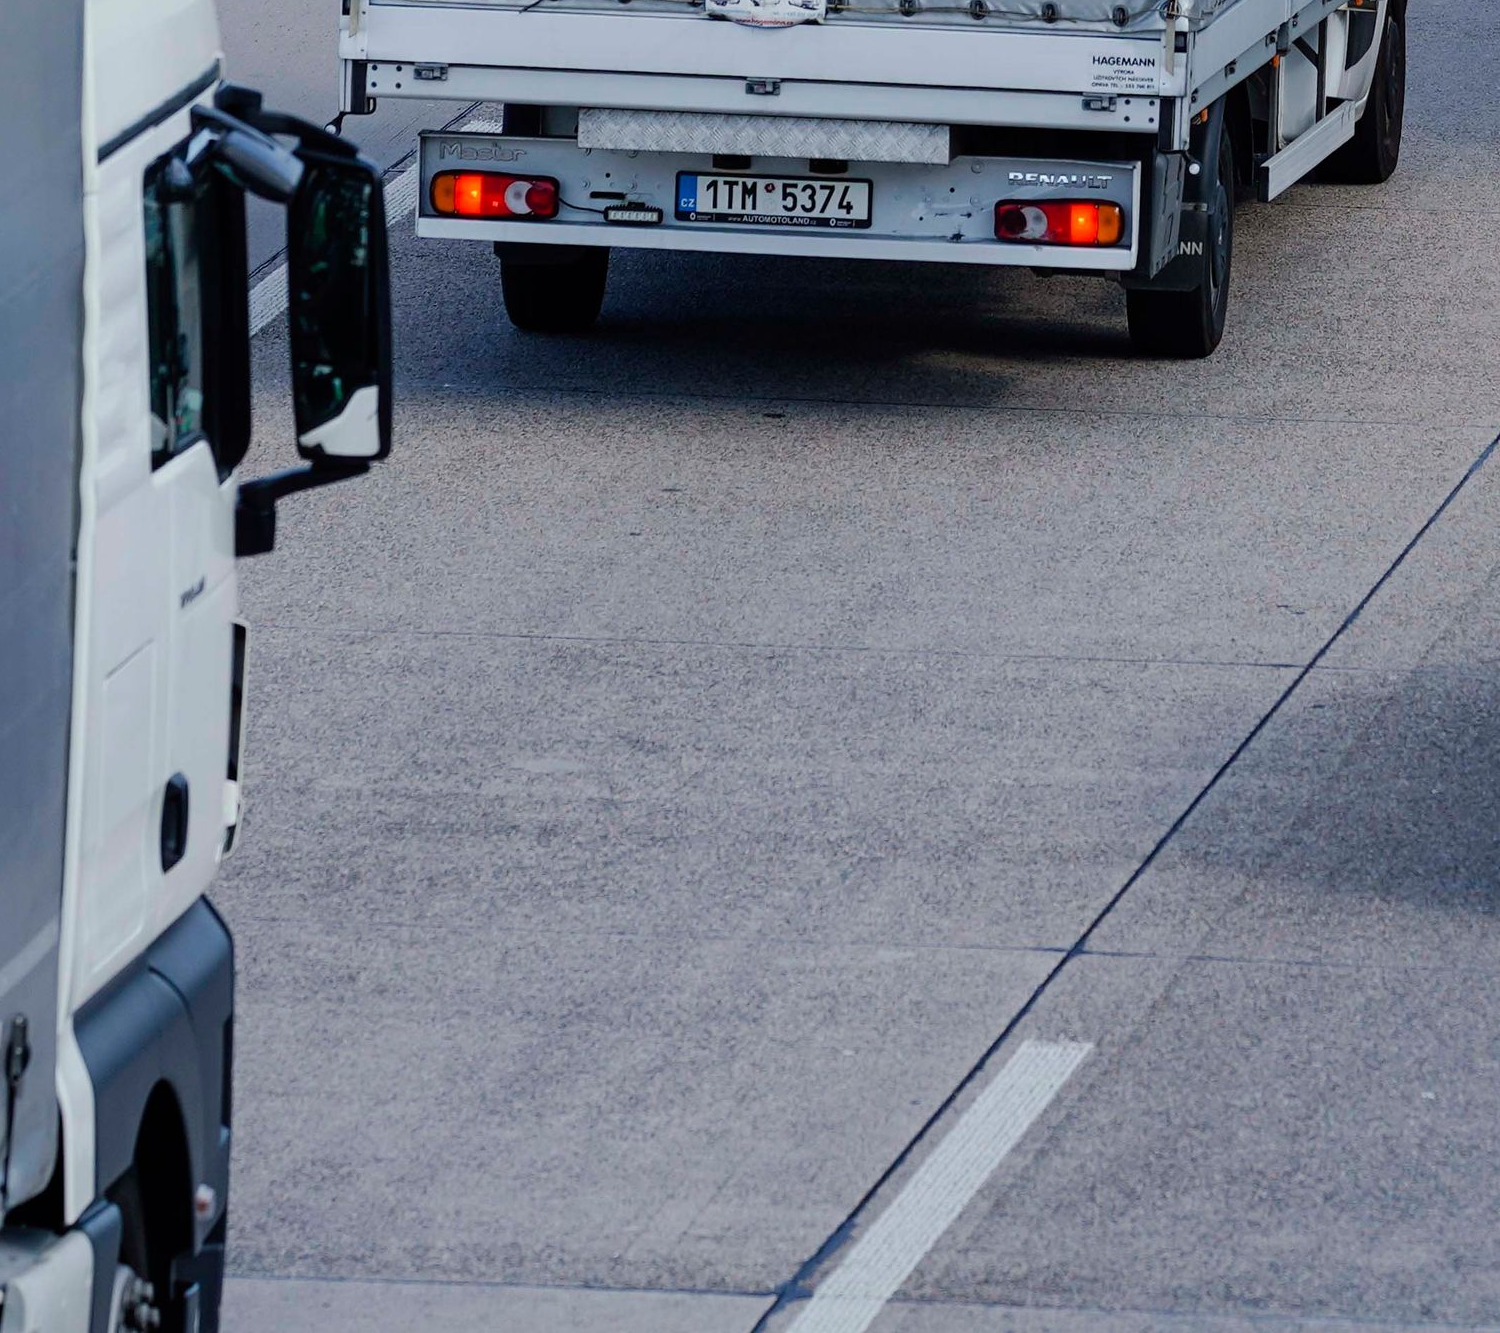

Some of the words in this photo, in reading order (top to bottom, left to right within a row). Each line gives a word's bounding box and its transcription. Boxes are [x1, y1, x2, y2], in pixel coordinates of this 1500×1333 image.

[1092, 55, 1156, 67] HAGEMANN
[440, 140, 528, 163] Master
[1008, 172, 1113, 190] RENAULT
[680, 198, 696, 208] CZ
[706, 179, 758, 211] 1TM
[781, 182, 854, 215] 5374
